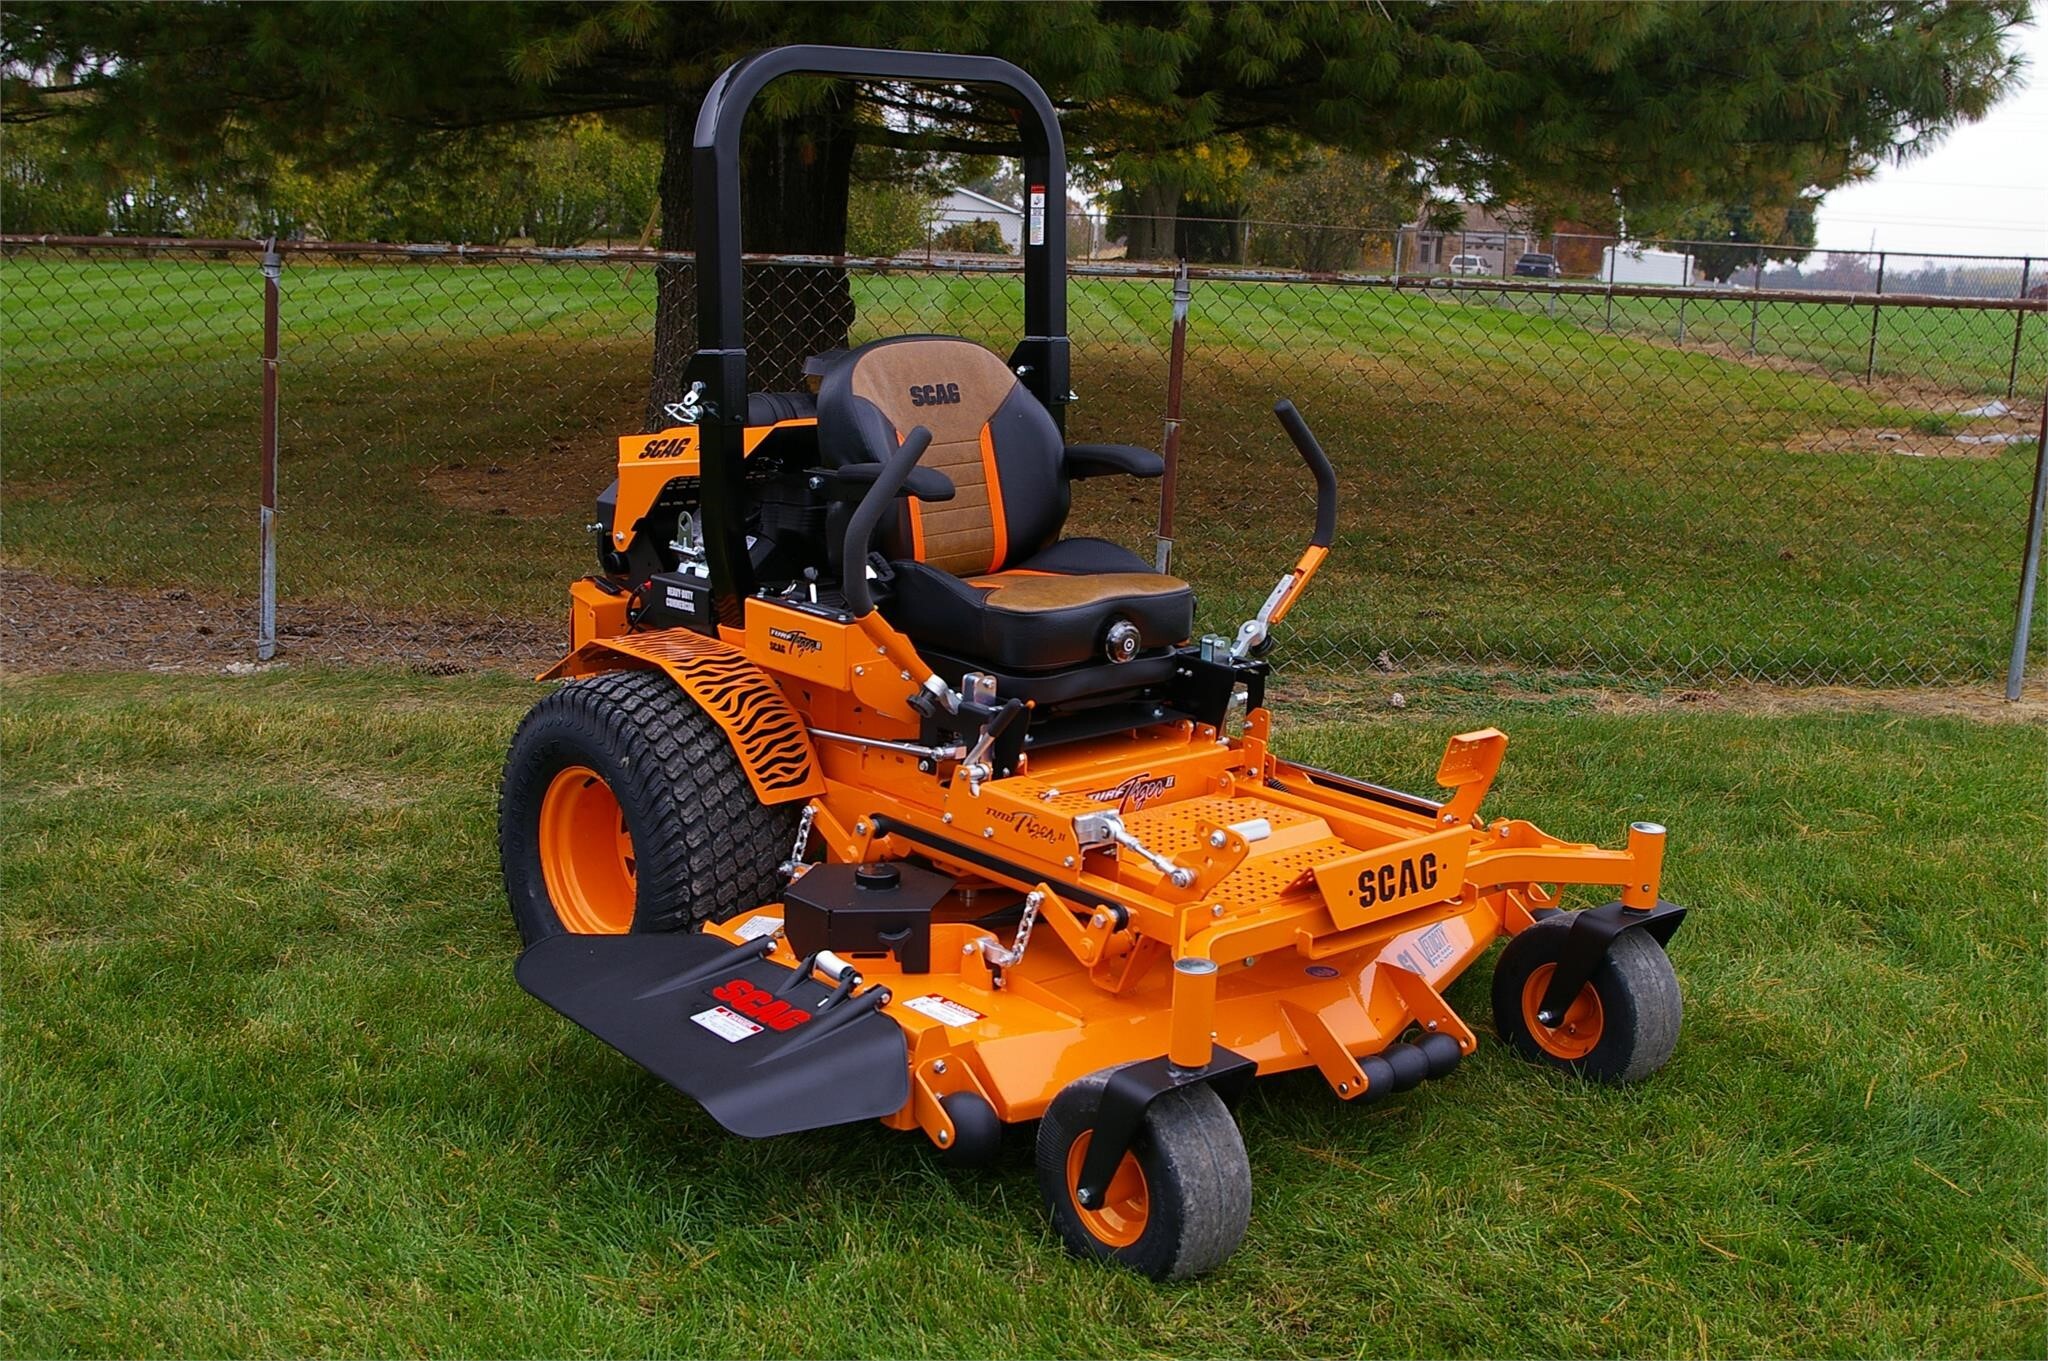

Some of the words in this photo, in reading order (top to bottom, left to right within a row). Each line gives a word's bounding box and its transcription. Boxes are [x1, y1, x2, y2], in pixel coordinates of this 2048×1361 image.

[909, 383, 960, 406] SCAG
[638, 437, 691, 459] SCAG
[769, 641, 786, 654] SCAG
[1116, 773, 1164, 815] Tiger
[1011, 811, 1057, 844] Tiger
[1358, 852, 1438, 908] SCAG
[712, 979, 813, 1030] SCAG
